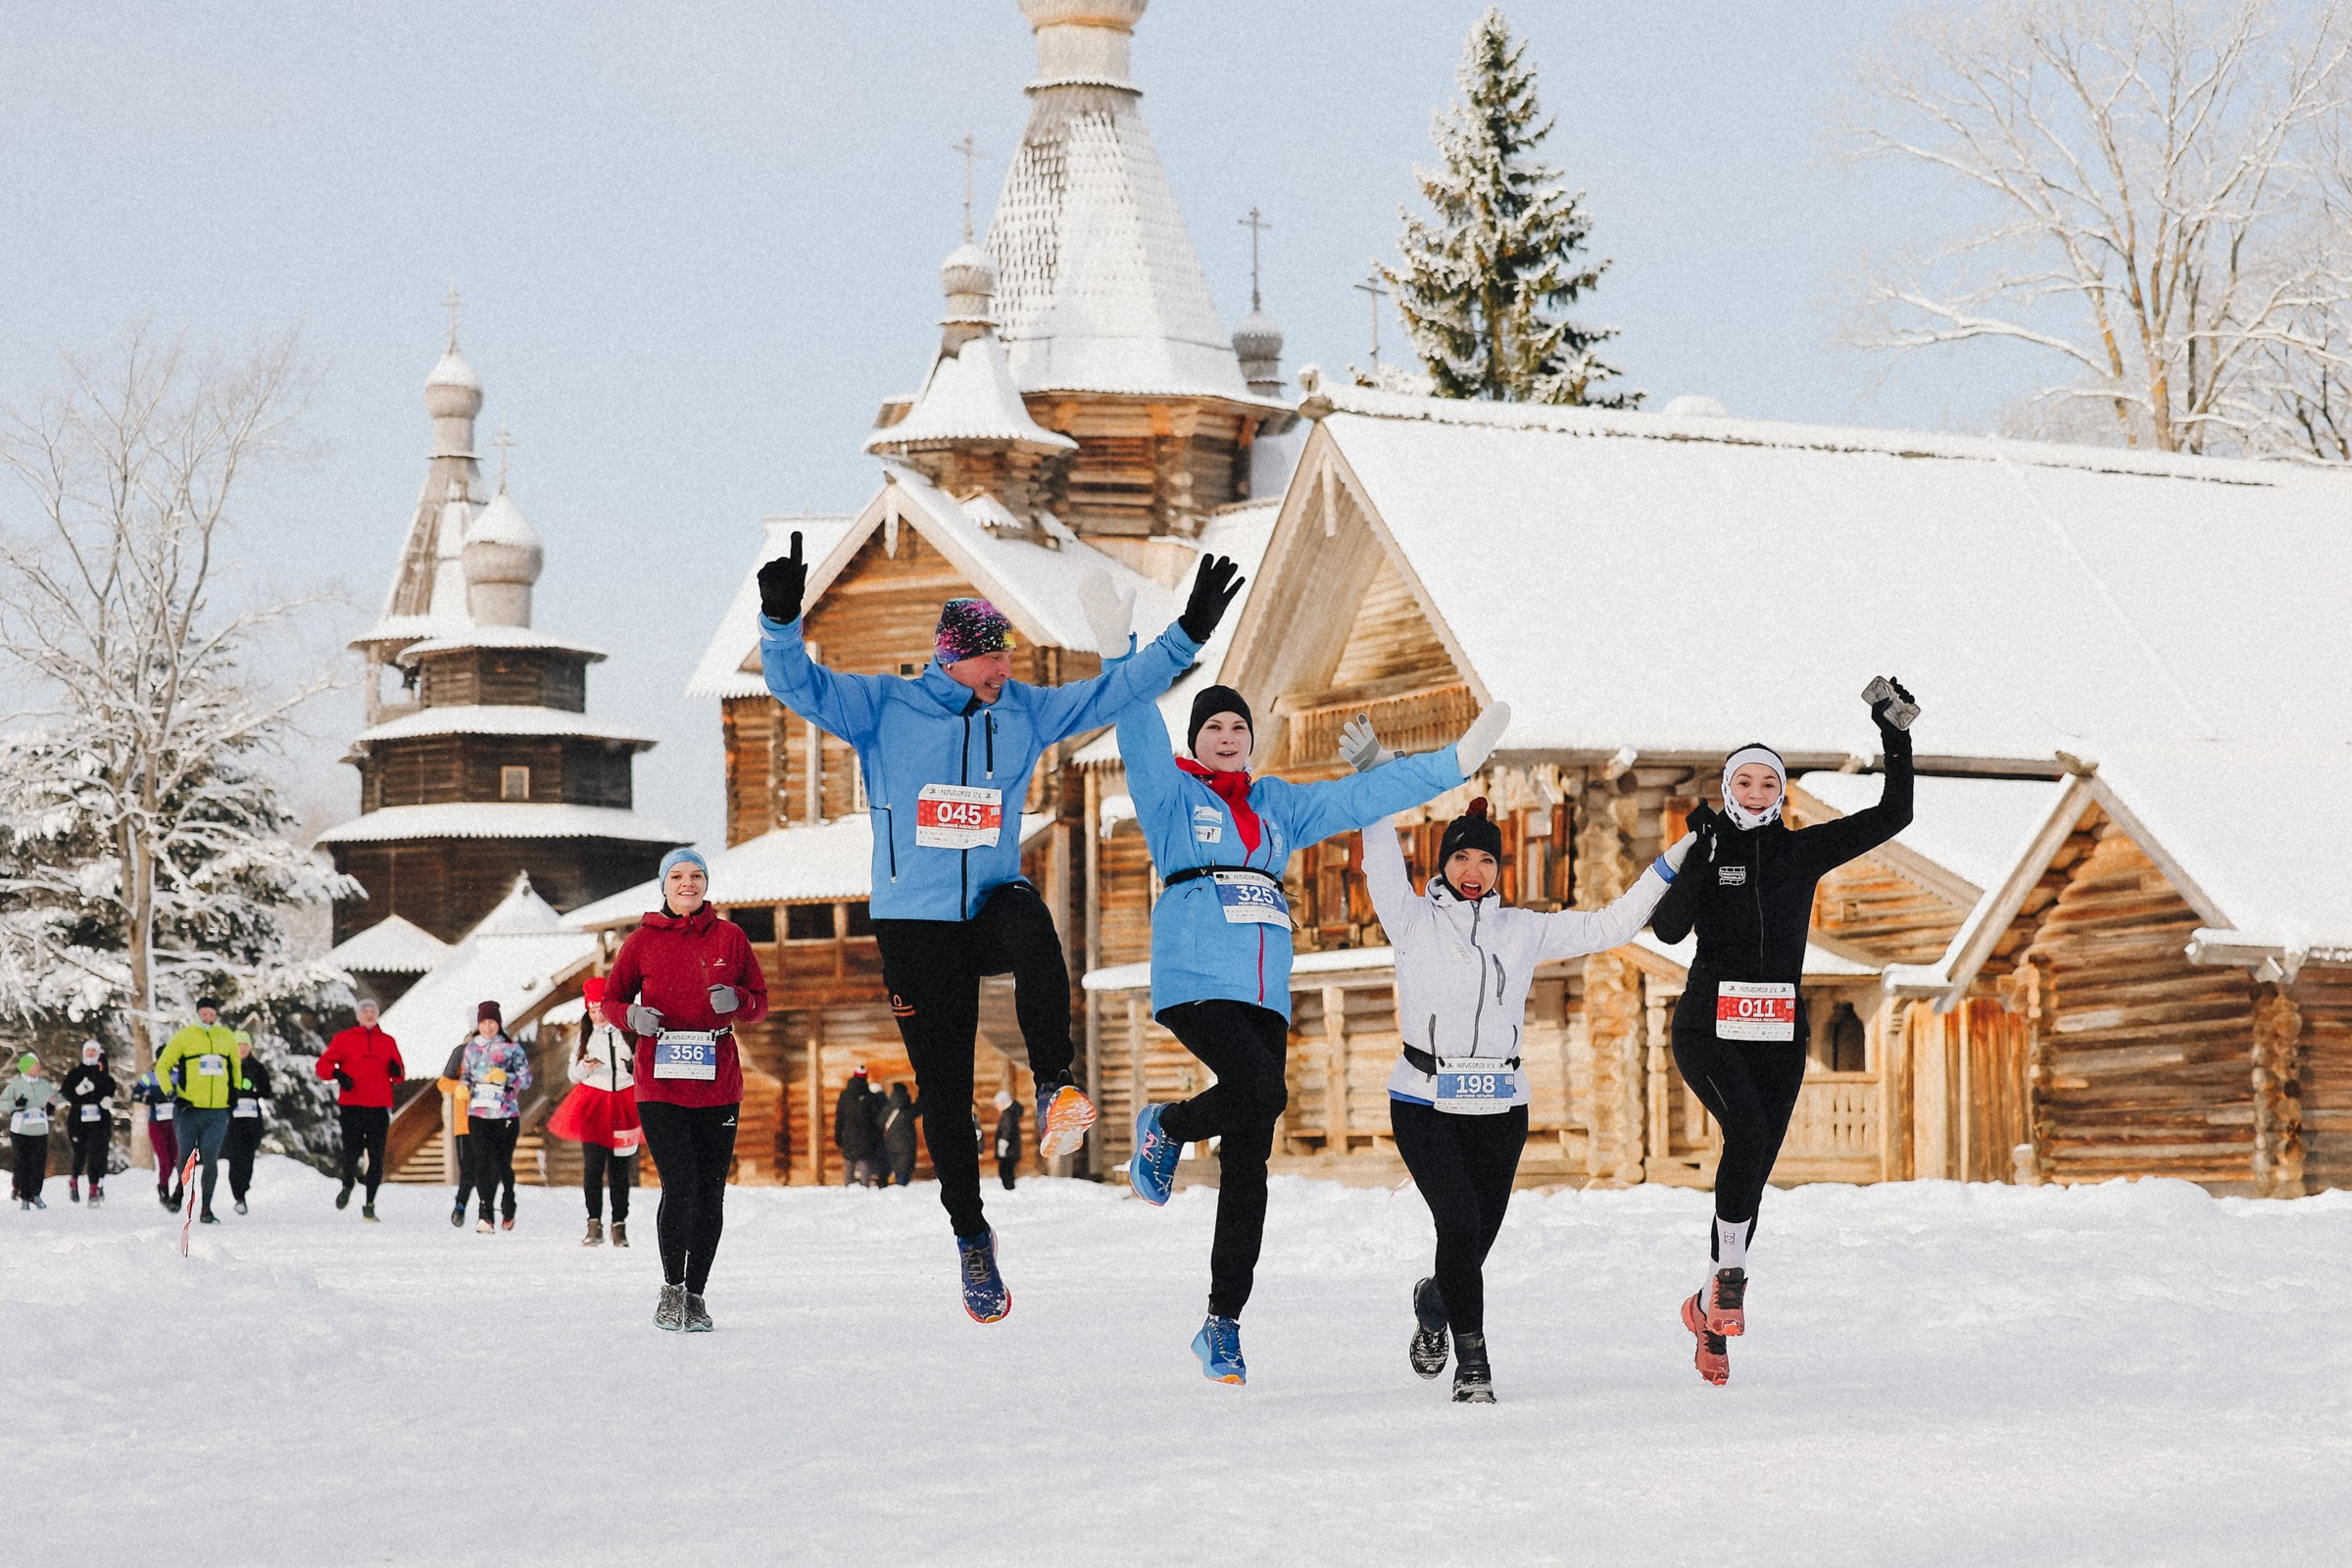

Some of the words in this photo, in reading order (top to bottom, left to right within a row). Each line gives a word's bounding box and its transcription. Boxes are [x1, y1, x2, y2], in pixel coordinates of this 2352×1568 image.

[937, 803, 982, 825] 045
[1236, 886, 1274, 905] 325
[1739, 999, 1776, 1018] 011
[669, 1045, 705, 1061] 356
[1456, 1074, 1495, 1094] 198
